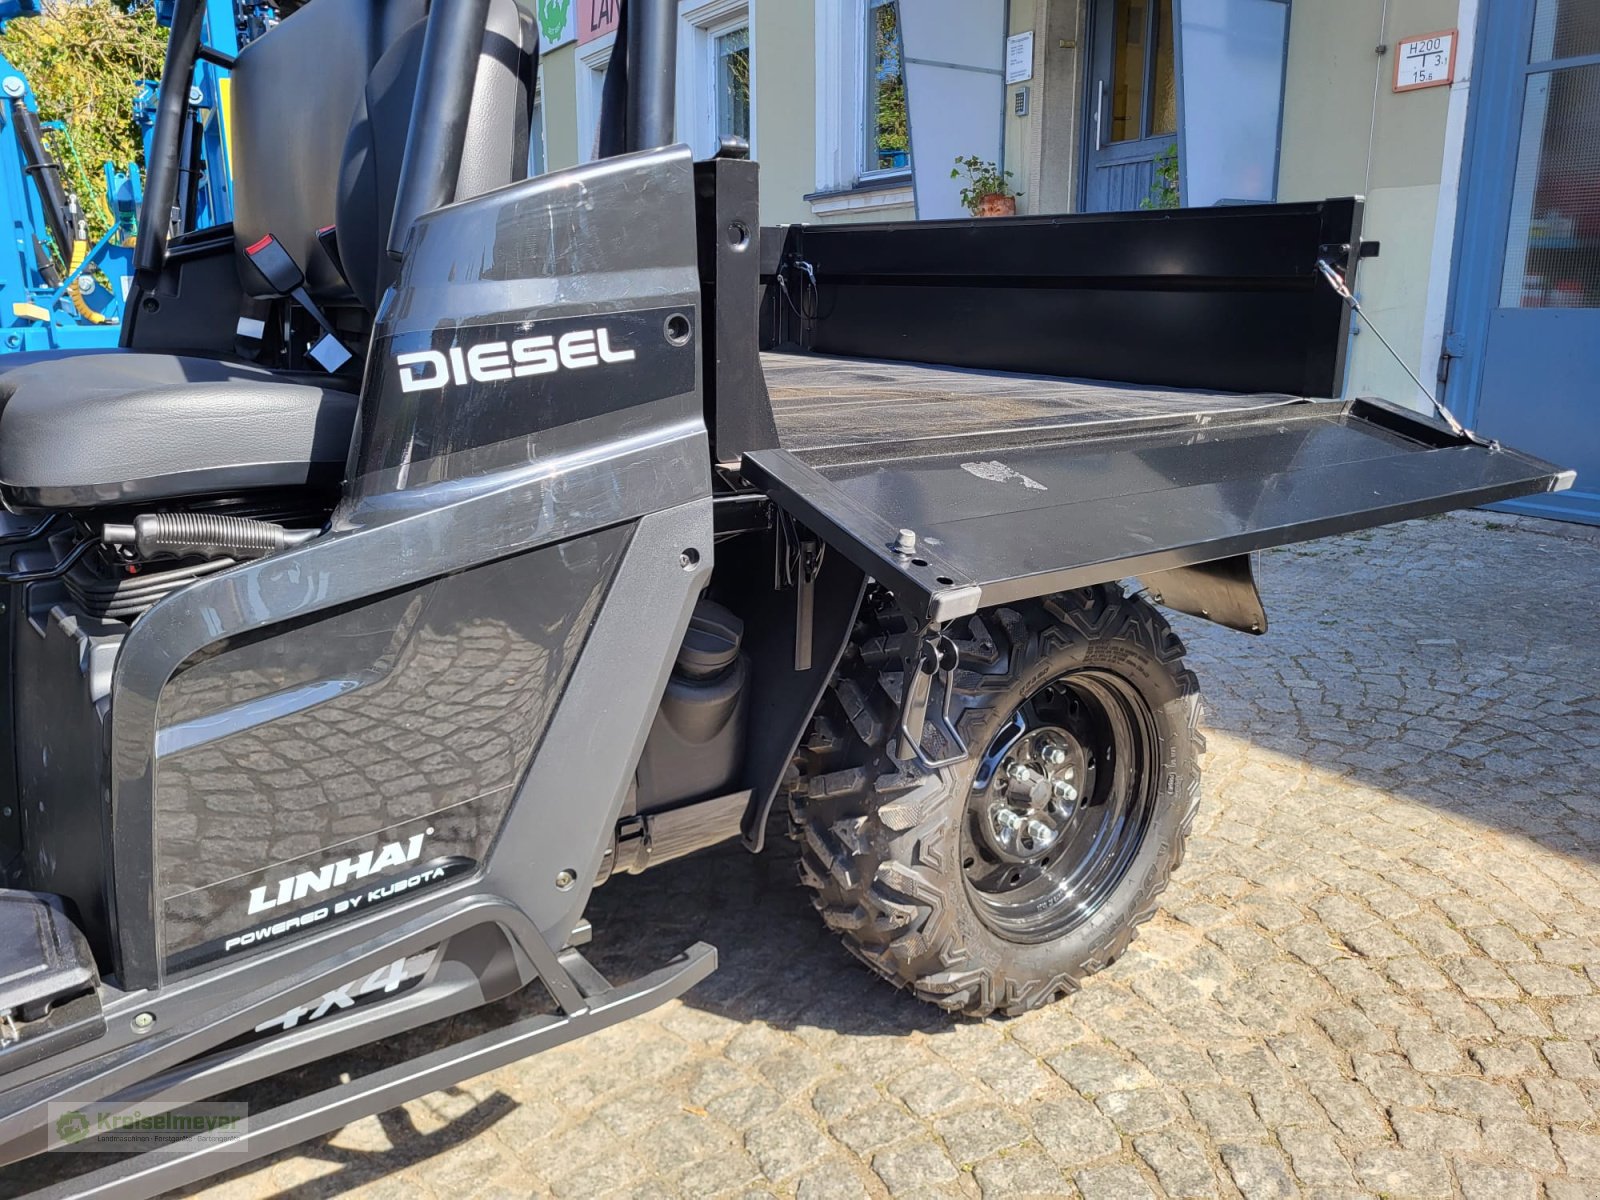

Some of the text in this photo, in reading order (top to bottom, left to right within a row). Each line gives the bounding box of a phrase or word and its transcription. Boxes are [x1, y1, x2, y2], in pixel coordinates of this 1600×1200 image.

[1409, 38, 1441, 54] H200
[397, 327, 635, 393] DIESEL
[225, 867, 445, 951] POWERED BY KUBOTA
[247, 833, 425, 915] LINHAI
